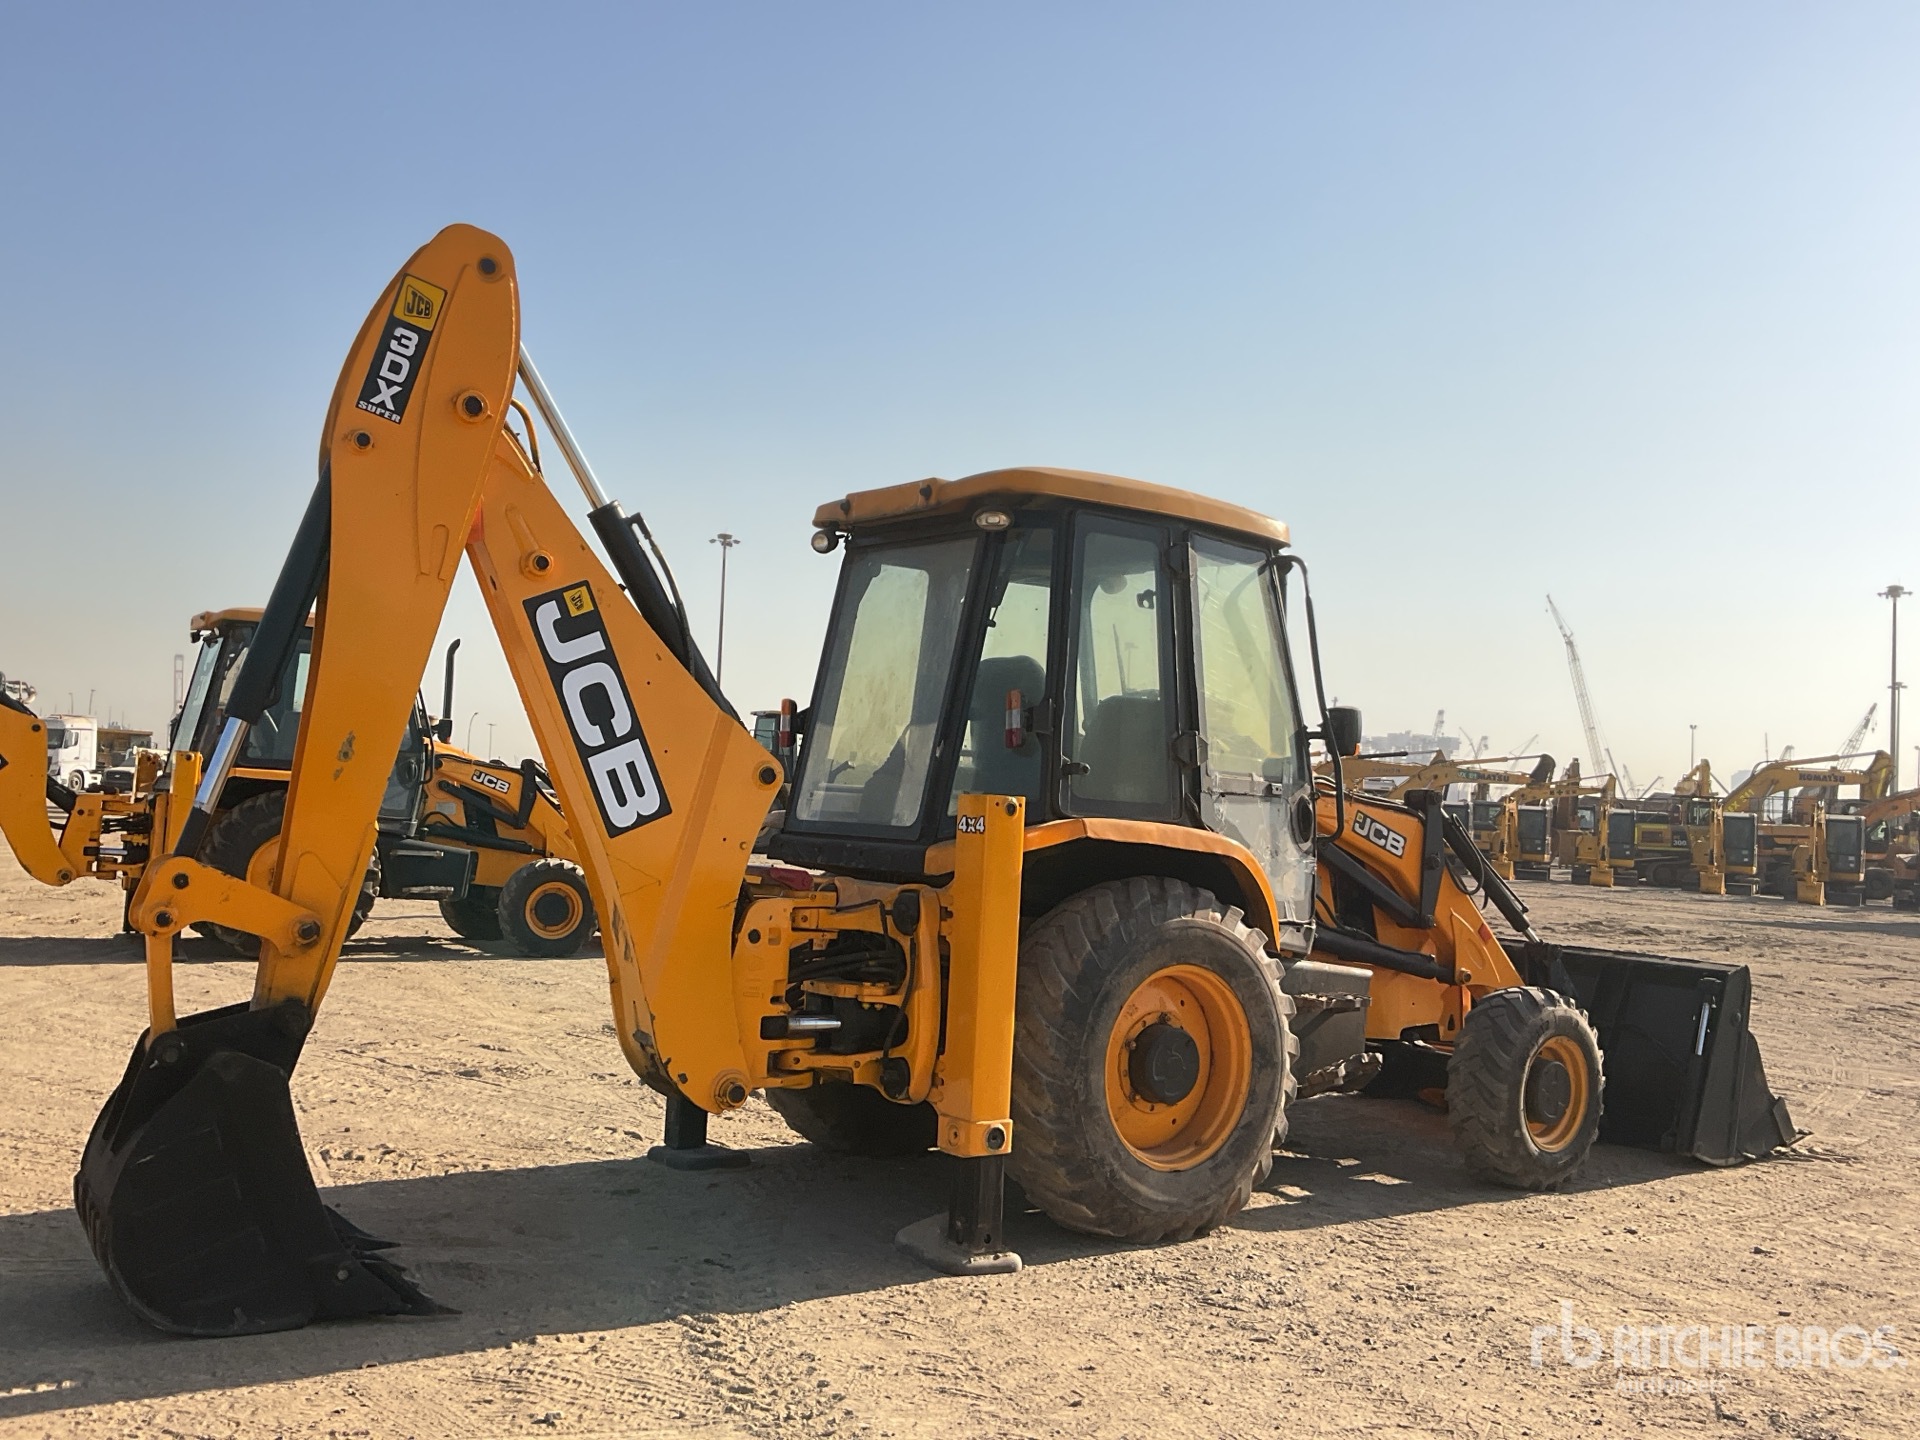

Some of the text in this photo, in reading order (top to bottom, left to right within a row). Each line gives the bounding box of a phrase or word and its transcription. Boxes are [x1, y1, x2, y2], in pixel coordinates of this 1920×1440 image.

[406, 290, 432, 318] JCB
[369, 327, 419, 411] 3DX
[358, 400, 401, 423] SUPER
[535, 600, 661, 828] JCB
[472, 772, 510, 793] JCB
[1799, 773, 1845, 783] KOMATSU
[1354, 817, 1405, 857] JCB
